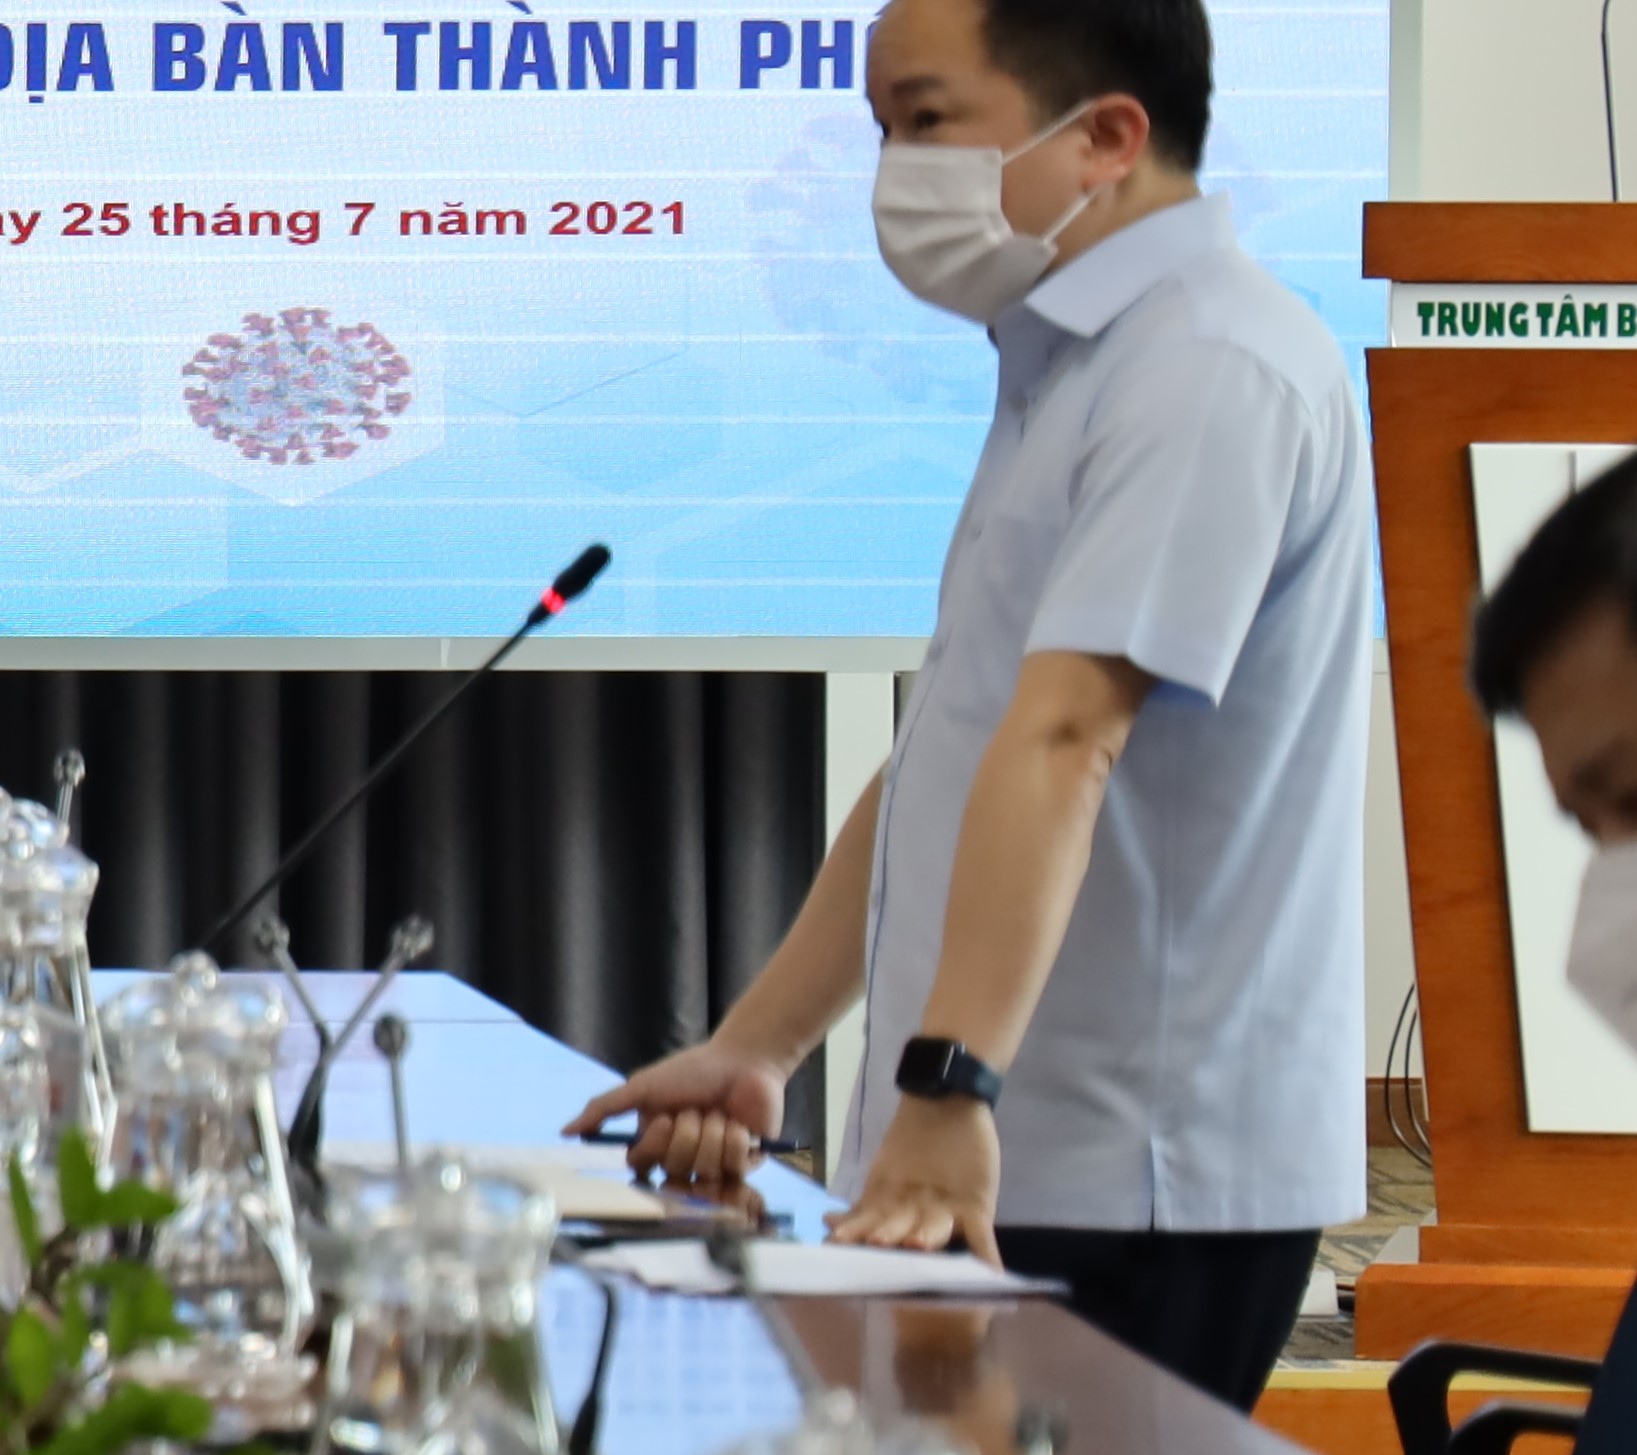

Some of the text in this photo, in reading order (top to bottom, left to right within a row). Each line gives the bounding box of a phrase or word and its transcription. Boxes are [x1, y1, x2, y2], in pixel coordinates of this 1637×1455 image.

[152, 1, 345, 92] BÀN
[382, 0, 697, 91] THÀNH
[738, 19, 872, 90] PH
[62, 202, 131, 236] 25
[149, 202, 321, 246] tháng
[345, 202, 376, 235] 7
[399, 201, 527, 235] năm
[549, 201, 685, 235] 2021
[1417, 301, 1529, 337] TRUNG
[1536, 294, 1608, 337] TÂM
